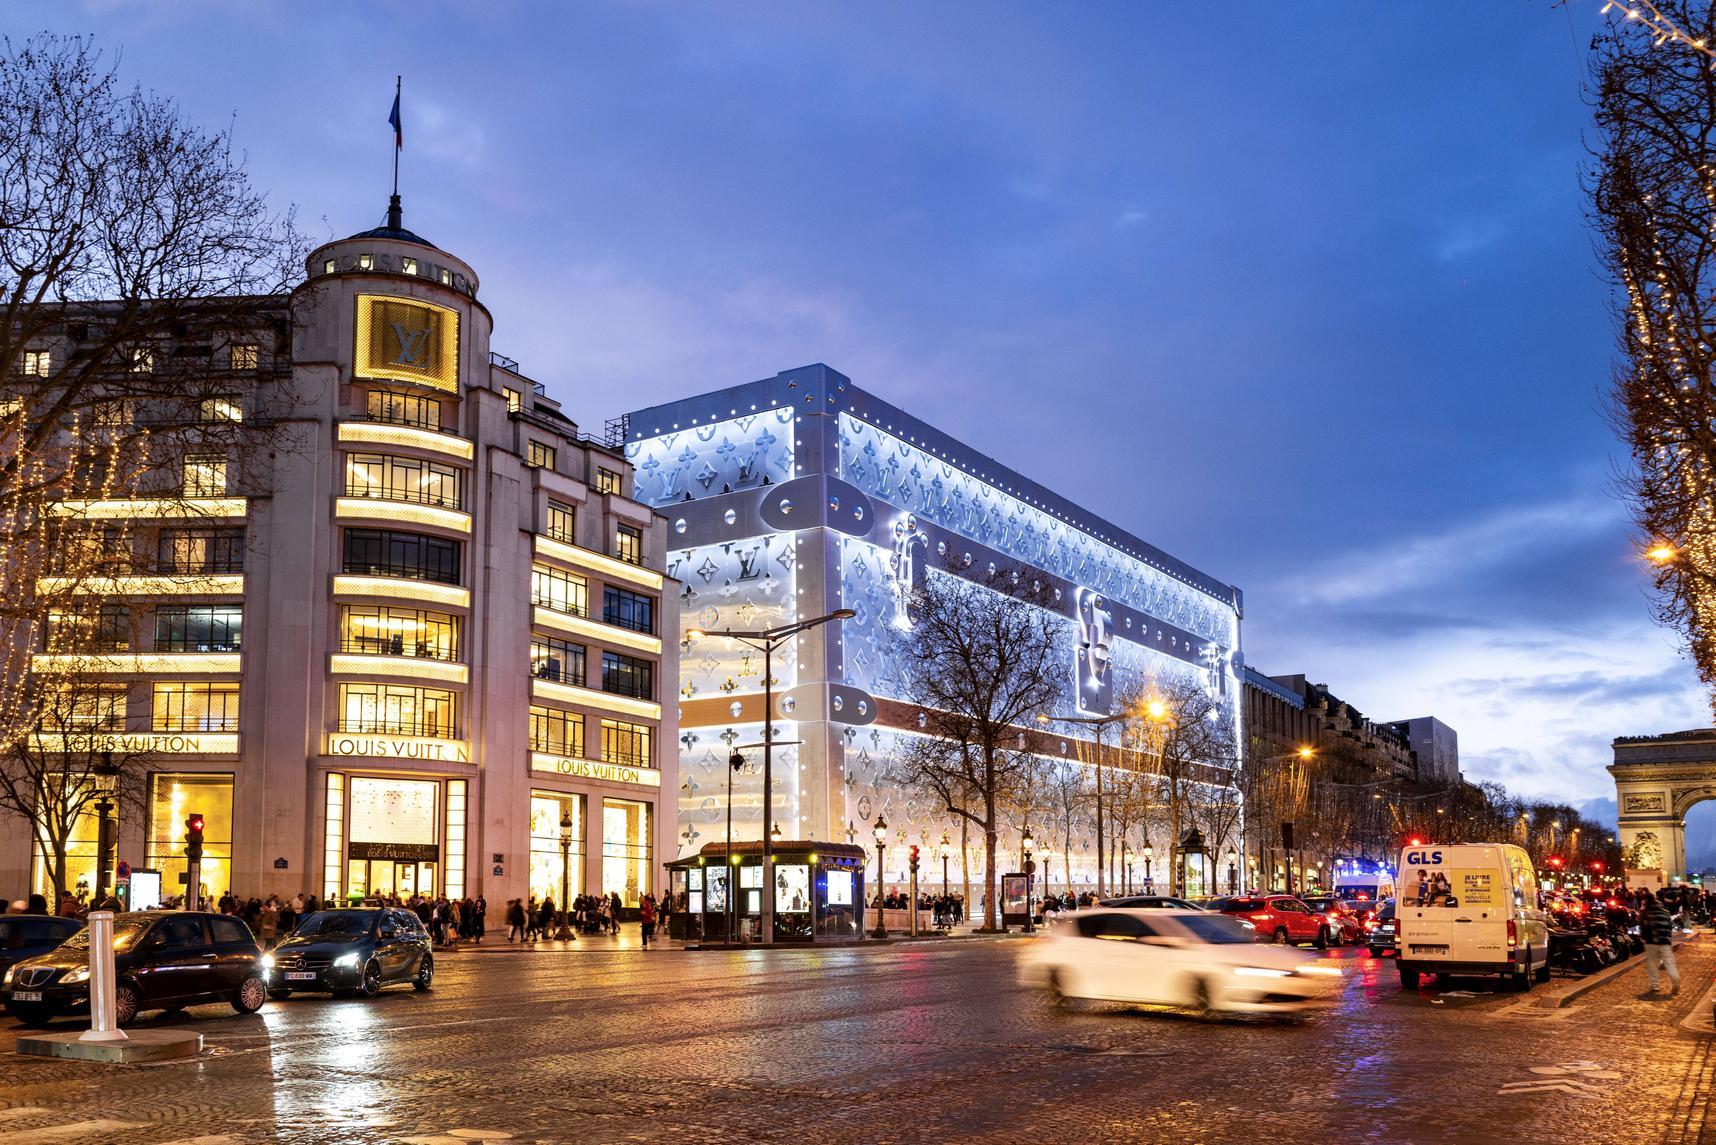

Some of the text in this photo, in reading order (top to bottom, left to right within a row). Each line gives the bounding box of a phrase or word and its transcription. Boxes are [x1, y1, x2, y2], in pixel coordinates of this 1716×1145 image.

[388, 323, 432, 368] LV
[65, 736, 200, 751] OUIS VUITTON
[331, 739, 469, 763] LOUIS VUITTN
[557, 759, 640, 783] LOUIS VUITTON
[1407, 851, 1443, 865] GLS
